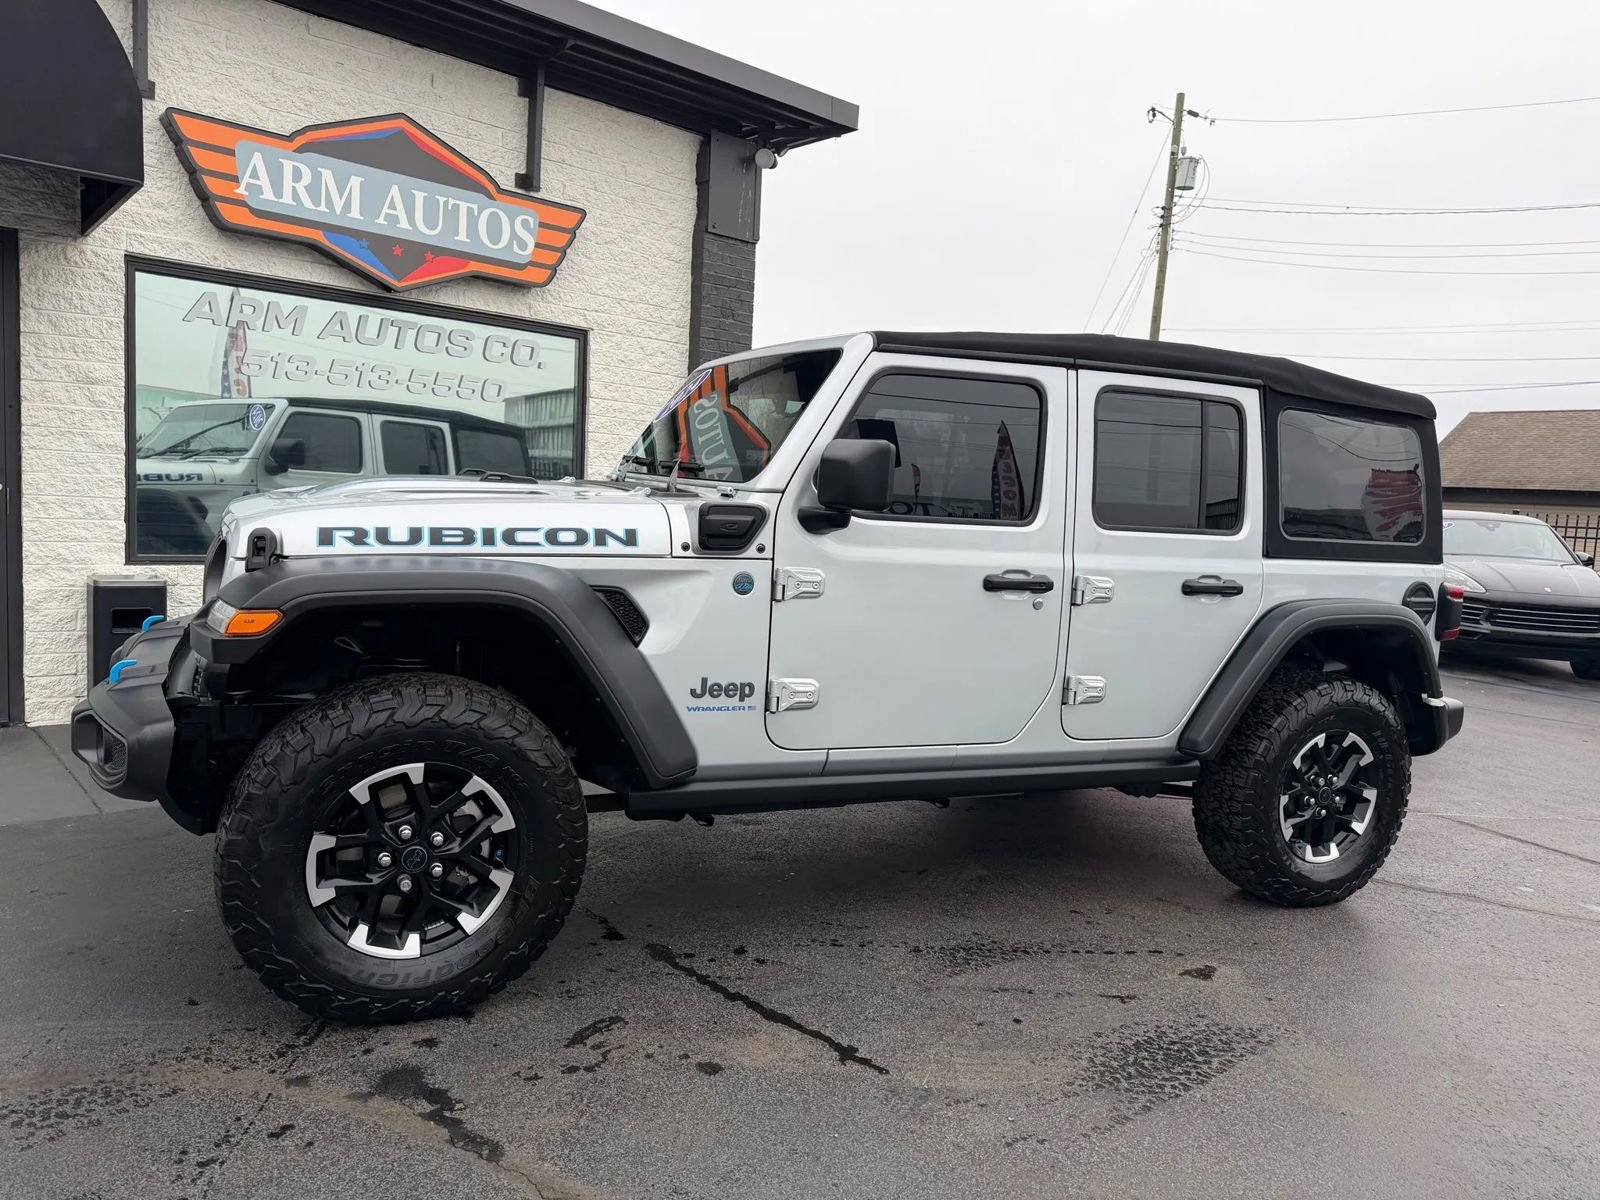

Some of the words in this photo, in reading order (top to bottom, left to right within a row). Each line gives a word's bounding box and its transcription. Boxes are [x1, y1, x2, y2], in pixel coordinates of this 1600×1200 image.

[234, 151, 365, 220] ARM
[376, 185, 536, 256] AUTOS
[182, 291, 308, 336] ARM
[317, 310, 476, 359] AUTOS
[482, 334, 548, 370] CO.
[240, 350, 506, 404] 513-513-5550
[317, 525, 638, 548] RUBICON
[689, 676, 755, 702] Jeep
